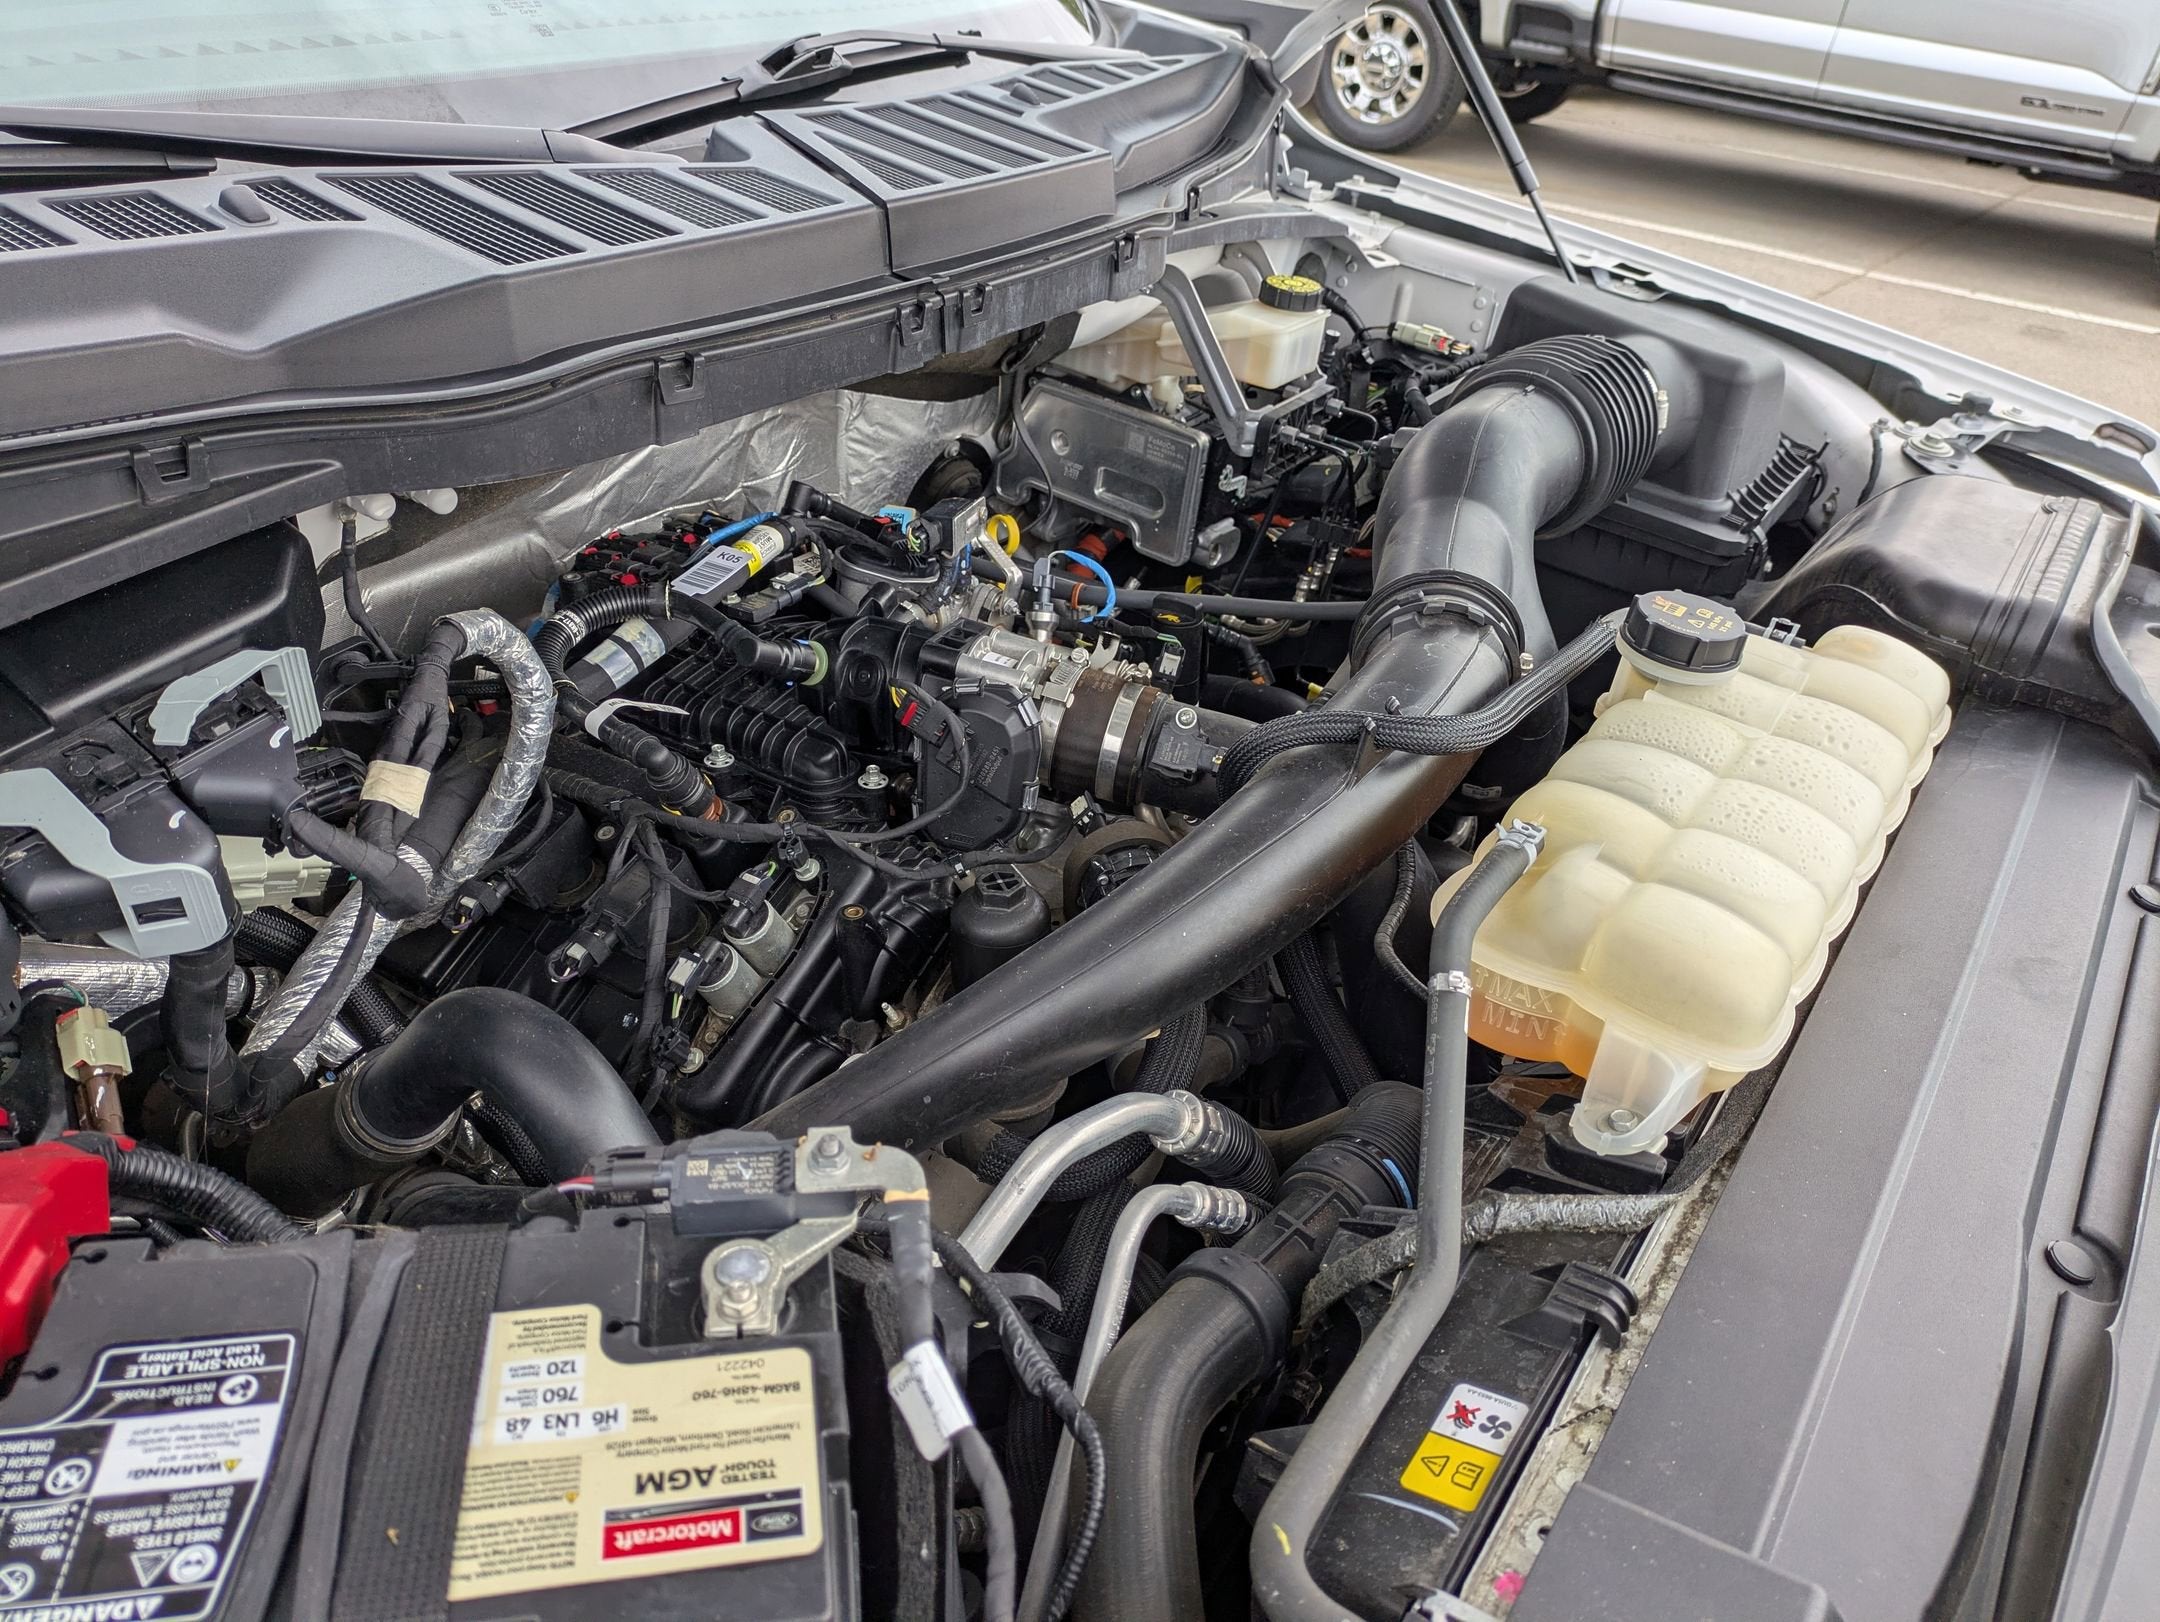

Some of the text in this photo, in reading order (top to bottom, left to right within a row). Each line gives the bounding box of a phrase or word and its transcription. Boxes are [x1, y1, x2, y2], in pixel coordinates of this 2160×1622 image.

[717, 551, 744, 565] K05
[1489, 974, 1553, 1013] MAX
[1482, 1001, 1550, 1041] MIN
[136, 1343, 259, 1364] Lead Acid Battery
[123, 1352, 265, 1379] NON-SPILLABLE
[546, 1360, 576, 1375] 120
[717, 1358, 764, 1371] 042221
[111, 1381, 216, 1401] INSTRUCTIONS.
[172, 1392, 212, 1407] READ
[542, 1386, 578, 1403] 760
[692, 1381, 800, 1401] BAGM-48H6-760
[505, 1417, 531, 1433] 48
[543, 1411, 580, 1429] LN3
[592, 1409, 618, 1426] H6
[727, 1433, 790, 1448] Manufactured
[6, 1453, 50, 1469] REACH
[157, 1451, 217, 1464] Cancer and
[616, 1446, 659, 1460] Company
[25, 1467, 44, 1482] OF
[127, 1461, 221, 1480] WARNING:
[720, 1471, 776, 1484] TESTED
[634, 1465, 717, 1494] AGM
[4, 1482, 38, 1497] KEEP
[215, 1485, 234, 1498] OR
[10, 1504, 69, 1522] SMOKING
[92, 1497, 231, 1525] CAN CAUSE BLINDNESS
[13, 1518, 64, 1534] FLAMES
[105, 1510, 227, 1538] EXPLOSIVE GASES
[8, 1531, 59, 1548] SPARKS
[173, 1525, 224, 1546] SHIELD
[613, 1518, 732, 1550] Motorcraft
[40, 1544, 64, 1560] NO
